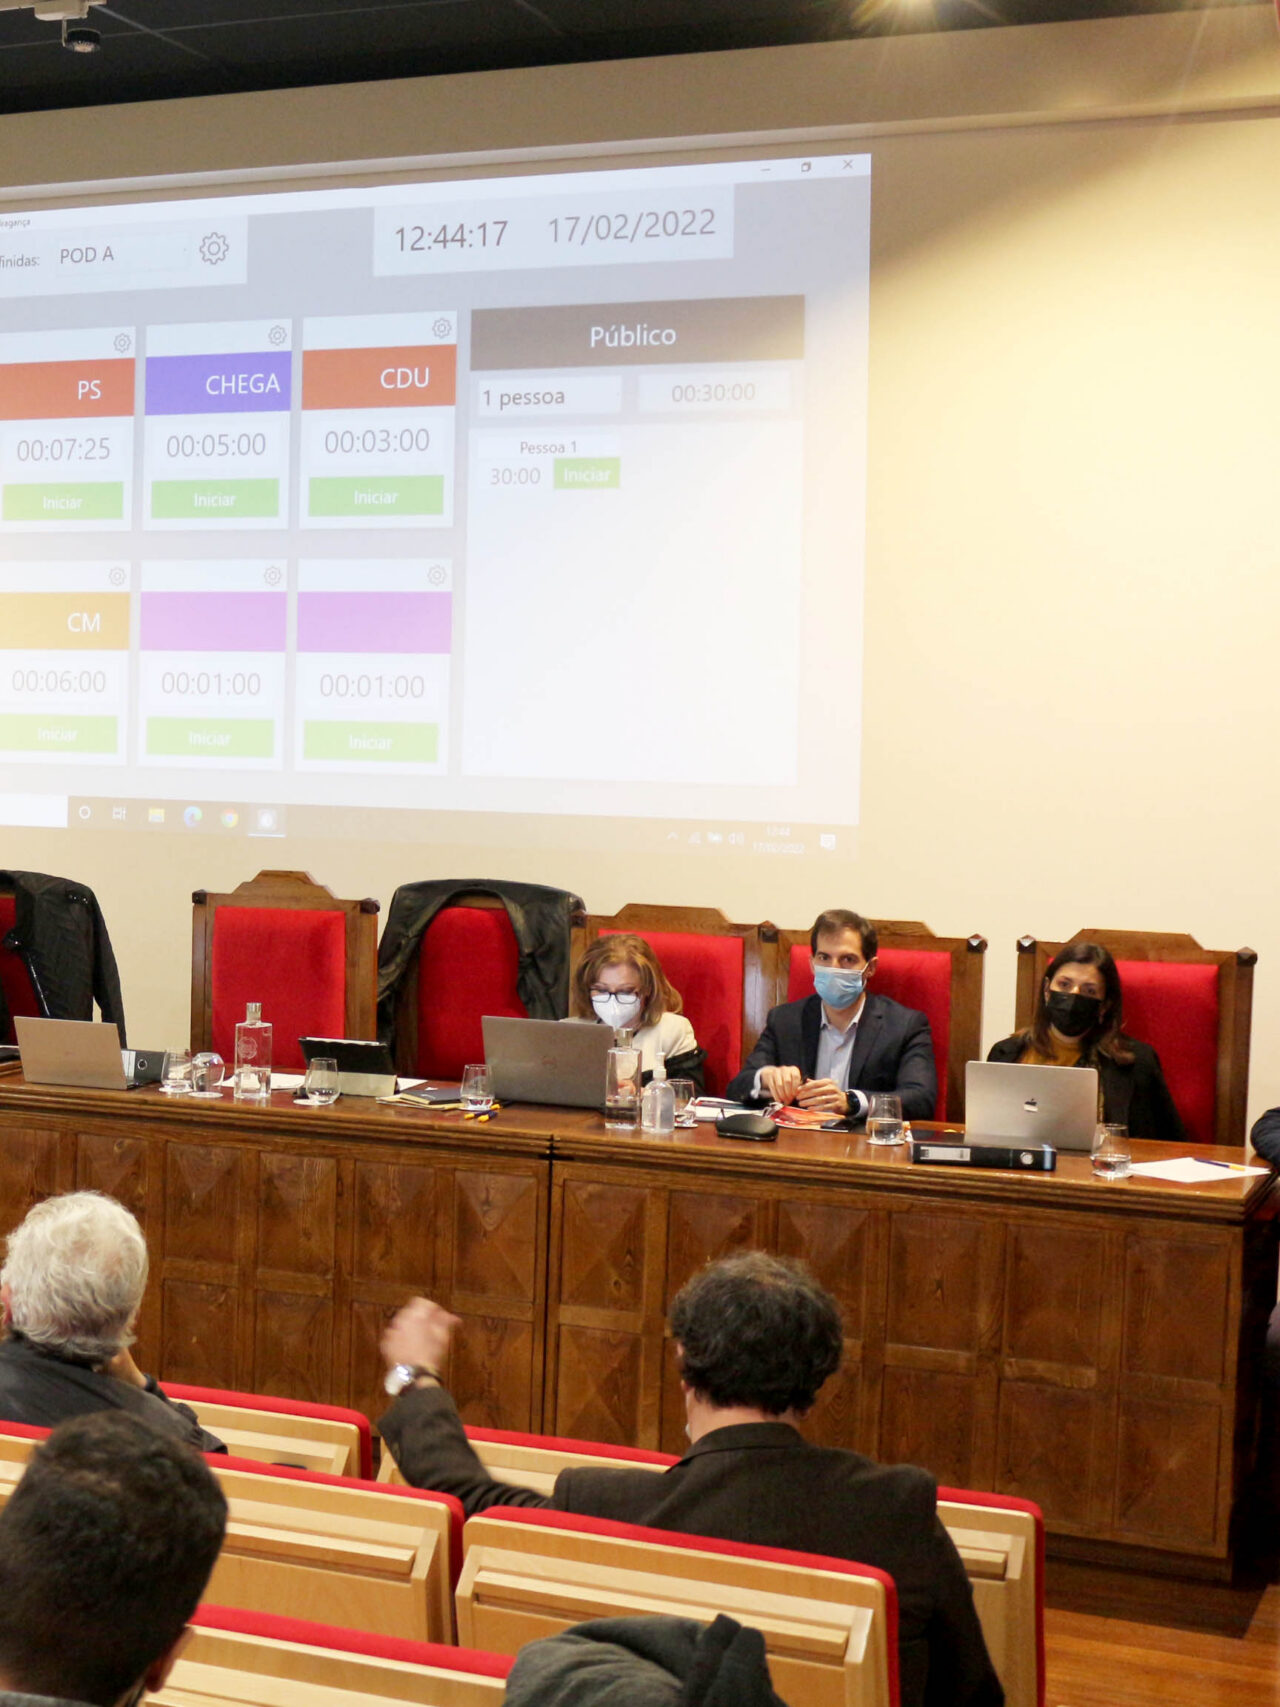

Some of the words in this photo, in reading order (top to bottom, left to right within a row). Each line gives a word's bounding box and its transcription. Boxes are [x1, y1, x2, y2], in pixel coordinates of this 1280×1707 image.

[395, 220, 509, 252] 12:44:17
[548, 208, 716, 246] 17/02/2022
[60, 246, 97, 265] POD
[102, 246, 115, 262] A
[590, 324, 677, 348] Público
[205, 373, 281, 396] CHEGA
[379, 367, 430, 389] CDU
[78, 380, 102, 400] PS
[483, 389, 491, 406] 1
[499, 390, 565, 411] pessoa
[671, 383, 756, 404] 00:30:00
[16, 437, 111, 462] 00:07:25
[166, 433, 266, 458] 00:05:00
[324, 428, 430, 454] 00:03:00
[520, 441, 565, 455] Pessoa
[570, 440, 577, 453] 1
[490, 466, 541, 486] 30:00
[564, 467, 611, 483] Iniciar
[42, 495, 82, 511] Iniciar
[194, 493, 236, 508] Iniciar
[354, 489, 399, 506] Iniciar
[67, 613, 102, 633] CM
[11, 669, 106, 694] 00:06:00
[161, 671, 262, 697] 00:01:00
[319, 673, 425, 699] 00:01:00
[37, 727, 78, 743] Iniciar
[189, 730, 231, 746] Iniciar
[348, 734, 393, 750] Iniciar
